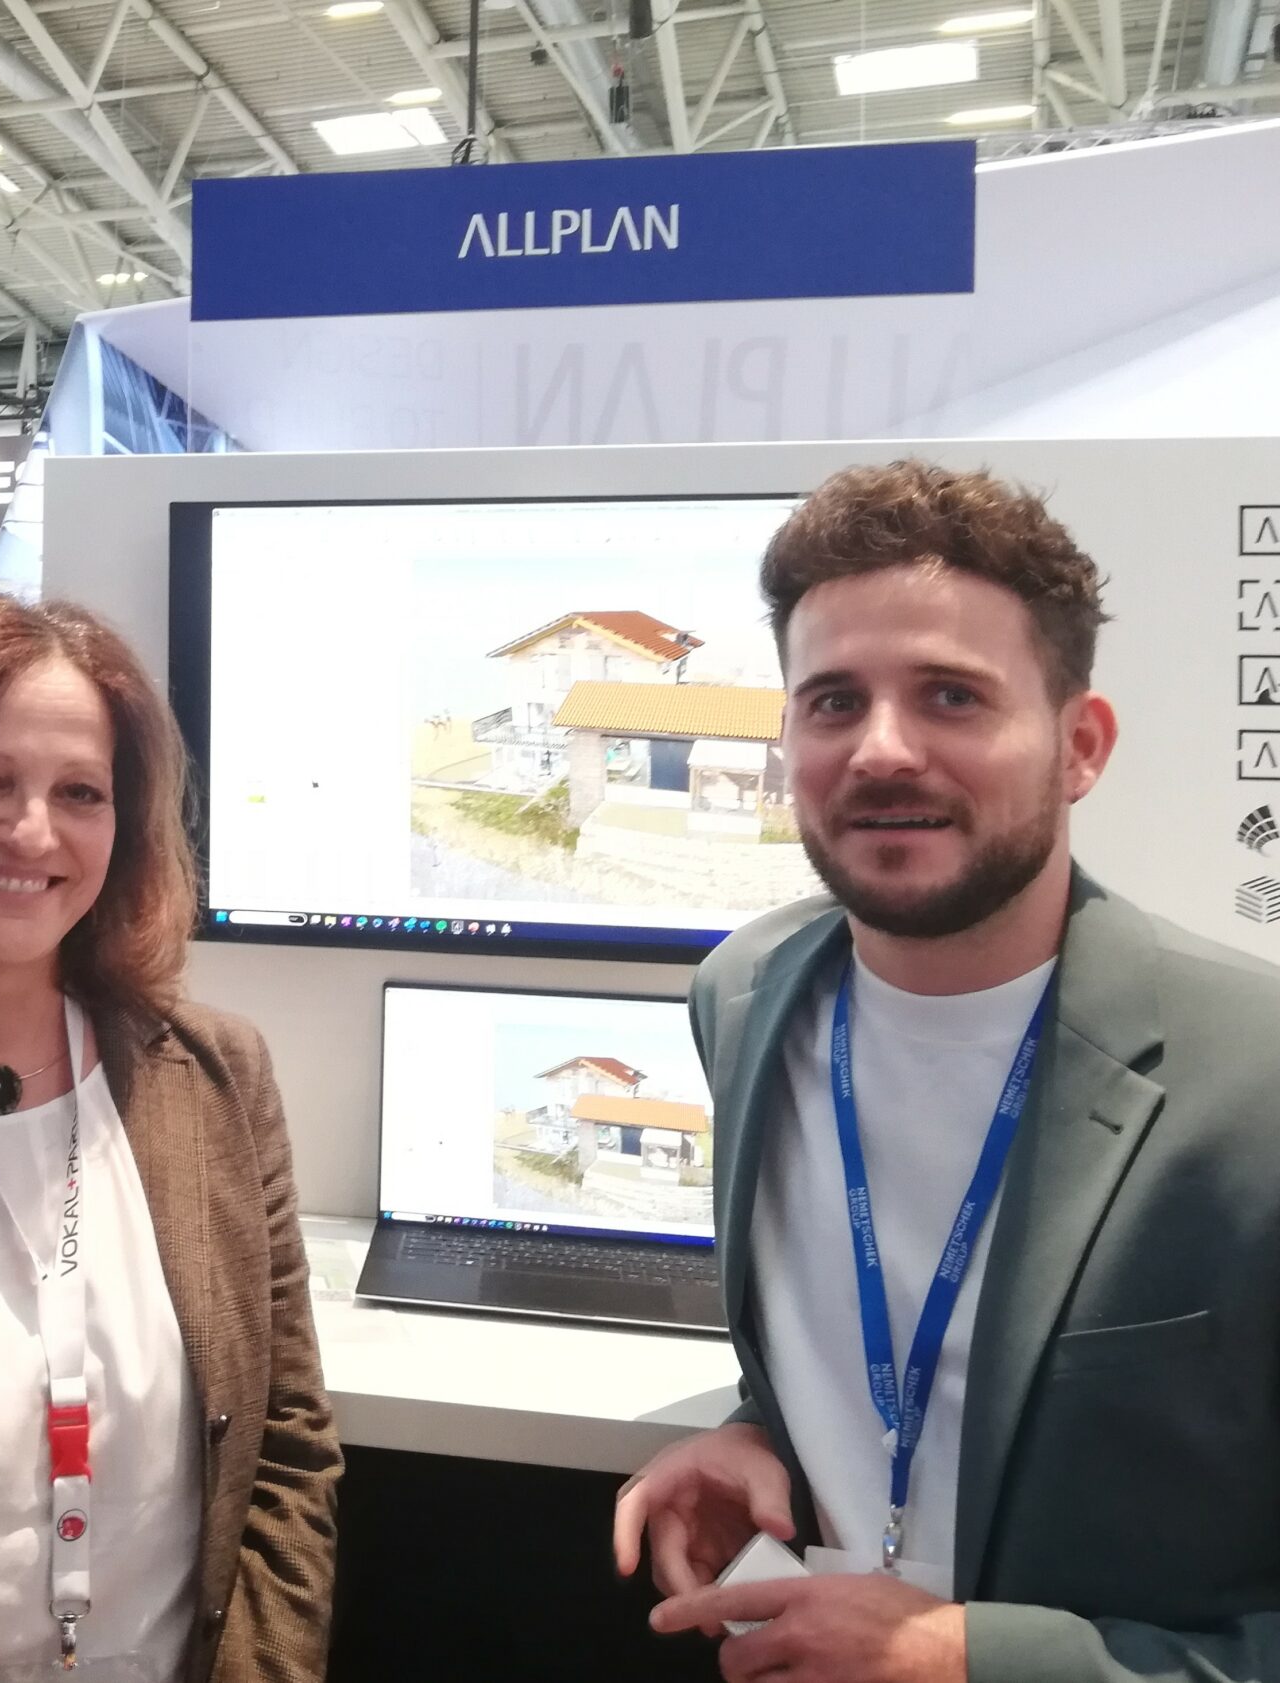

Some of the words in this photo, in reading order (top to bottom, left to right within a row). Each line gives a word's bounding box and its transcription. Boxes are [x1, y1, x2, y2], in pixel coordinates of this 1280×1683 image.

[457, 203, 680, 259] ALLPLAN
[848, 1188, 861, 1230] GROUP
[857, 1186, 879, 1269] NEMETSCHEK
[939, 1200, 977, 1279] NEMETSCHEK
